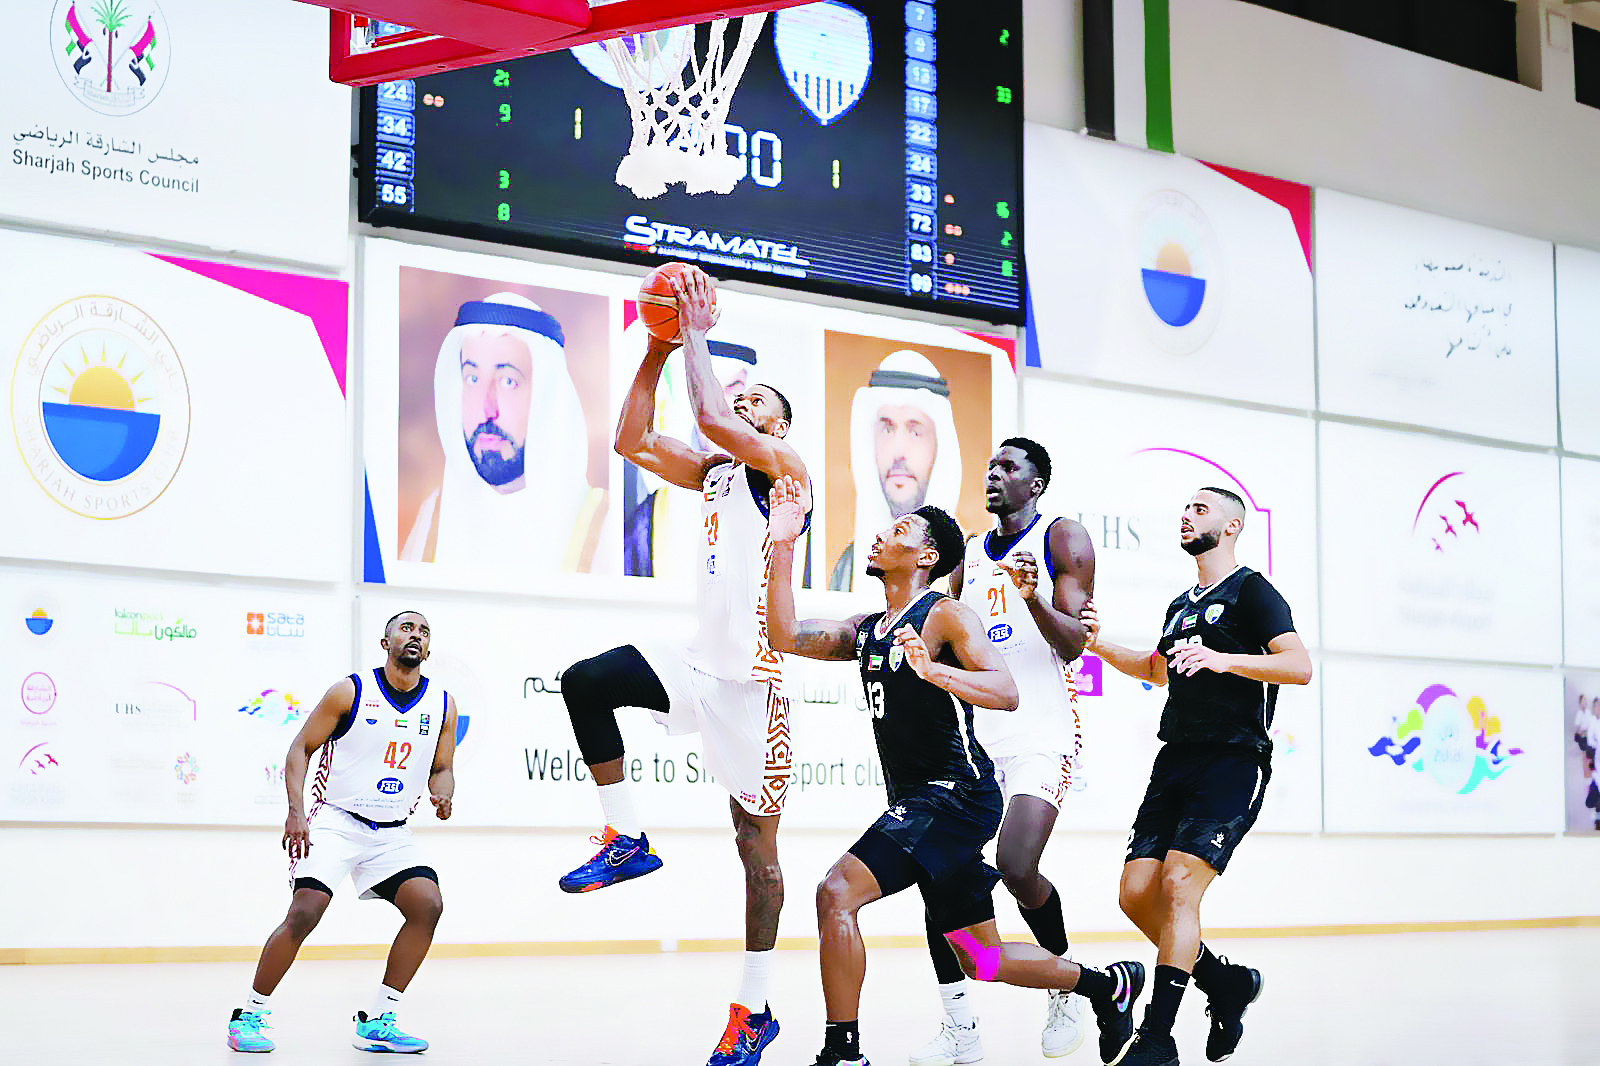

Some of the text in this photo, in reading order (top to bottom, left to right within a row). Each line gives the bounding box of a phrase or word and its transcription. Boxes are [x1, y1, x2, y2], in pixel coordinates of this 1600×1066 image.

[12, 123, 80, 149] الرياضي
[382, 115, 407, 136] 34
[910, 123, 932, 142] 22
[12, 148, 200, 193] Sharjah Sports Council
[147, 147, 200, 168] مجلس
[381, 152, 407, 171] 42
[381, 183, 407, 205] 55
[911, 212, 932, 233] 72
[623, 215, 811, 266] STRAMATEL
[23, 415, 77, 501] SHARJAH
[84, 481, 152, 511] SPORTS
[987, 584, 1007, 616] 21
[267, 612, 305, 625] sata
[866, 681, 885, 719] 13
[383, 741, 412, 770] 42
[653, 753, 677, 784] to
